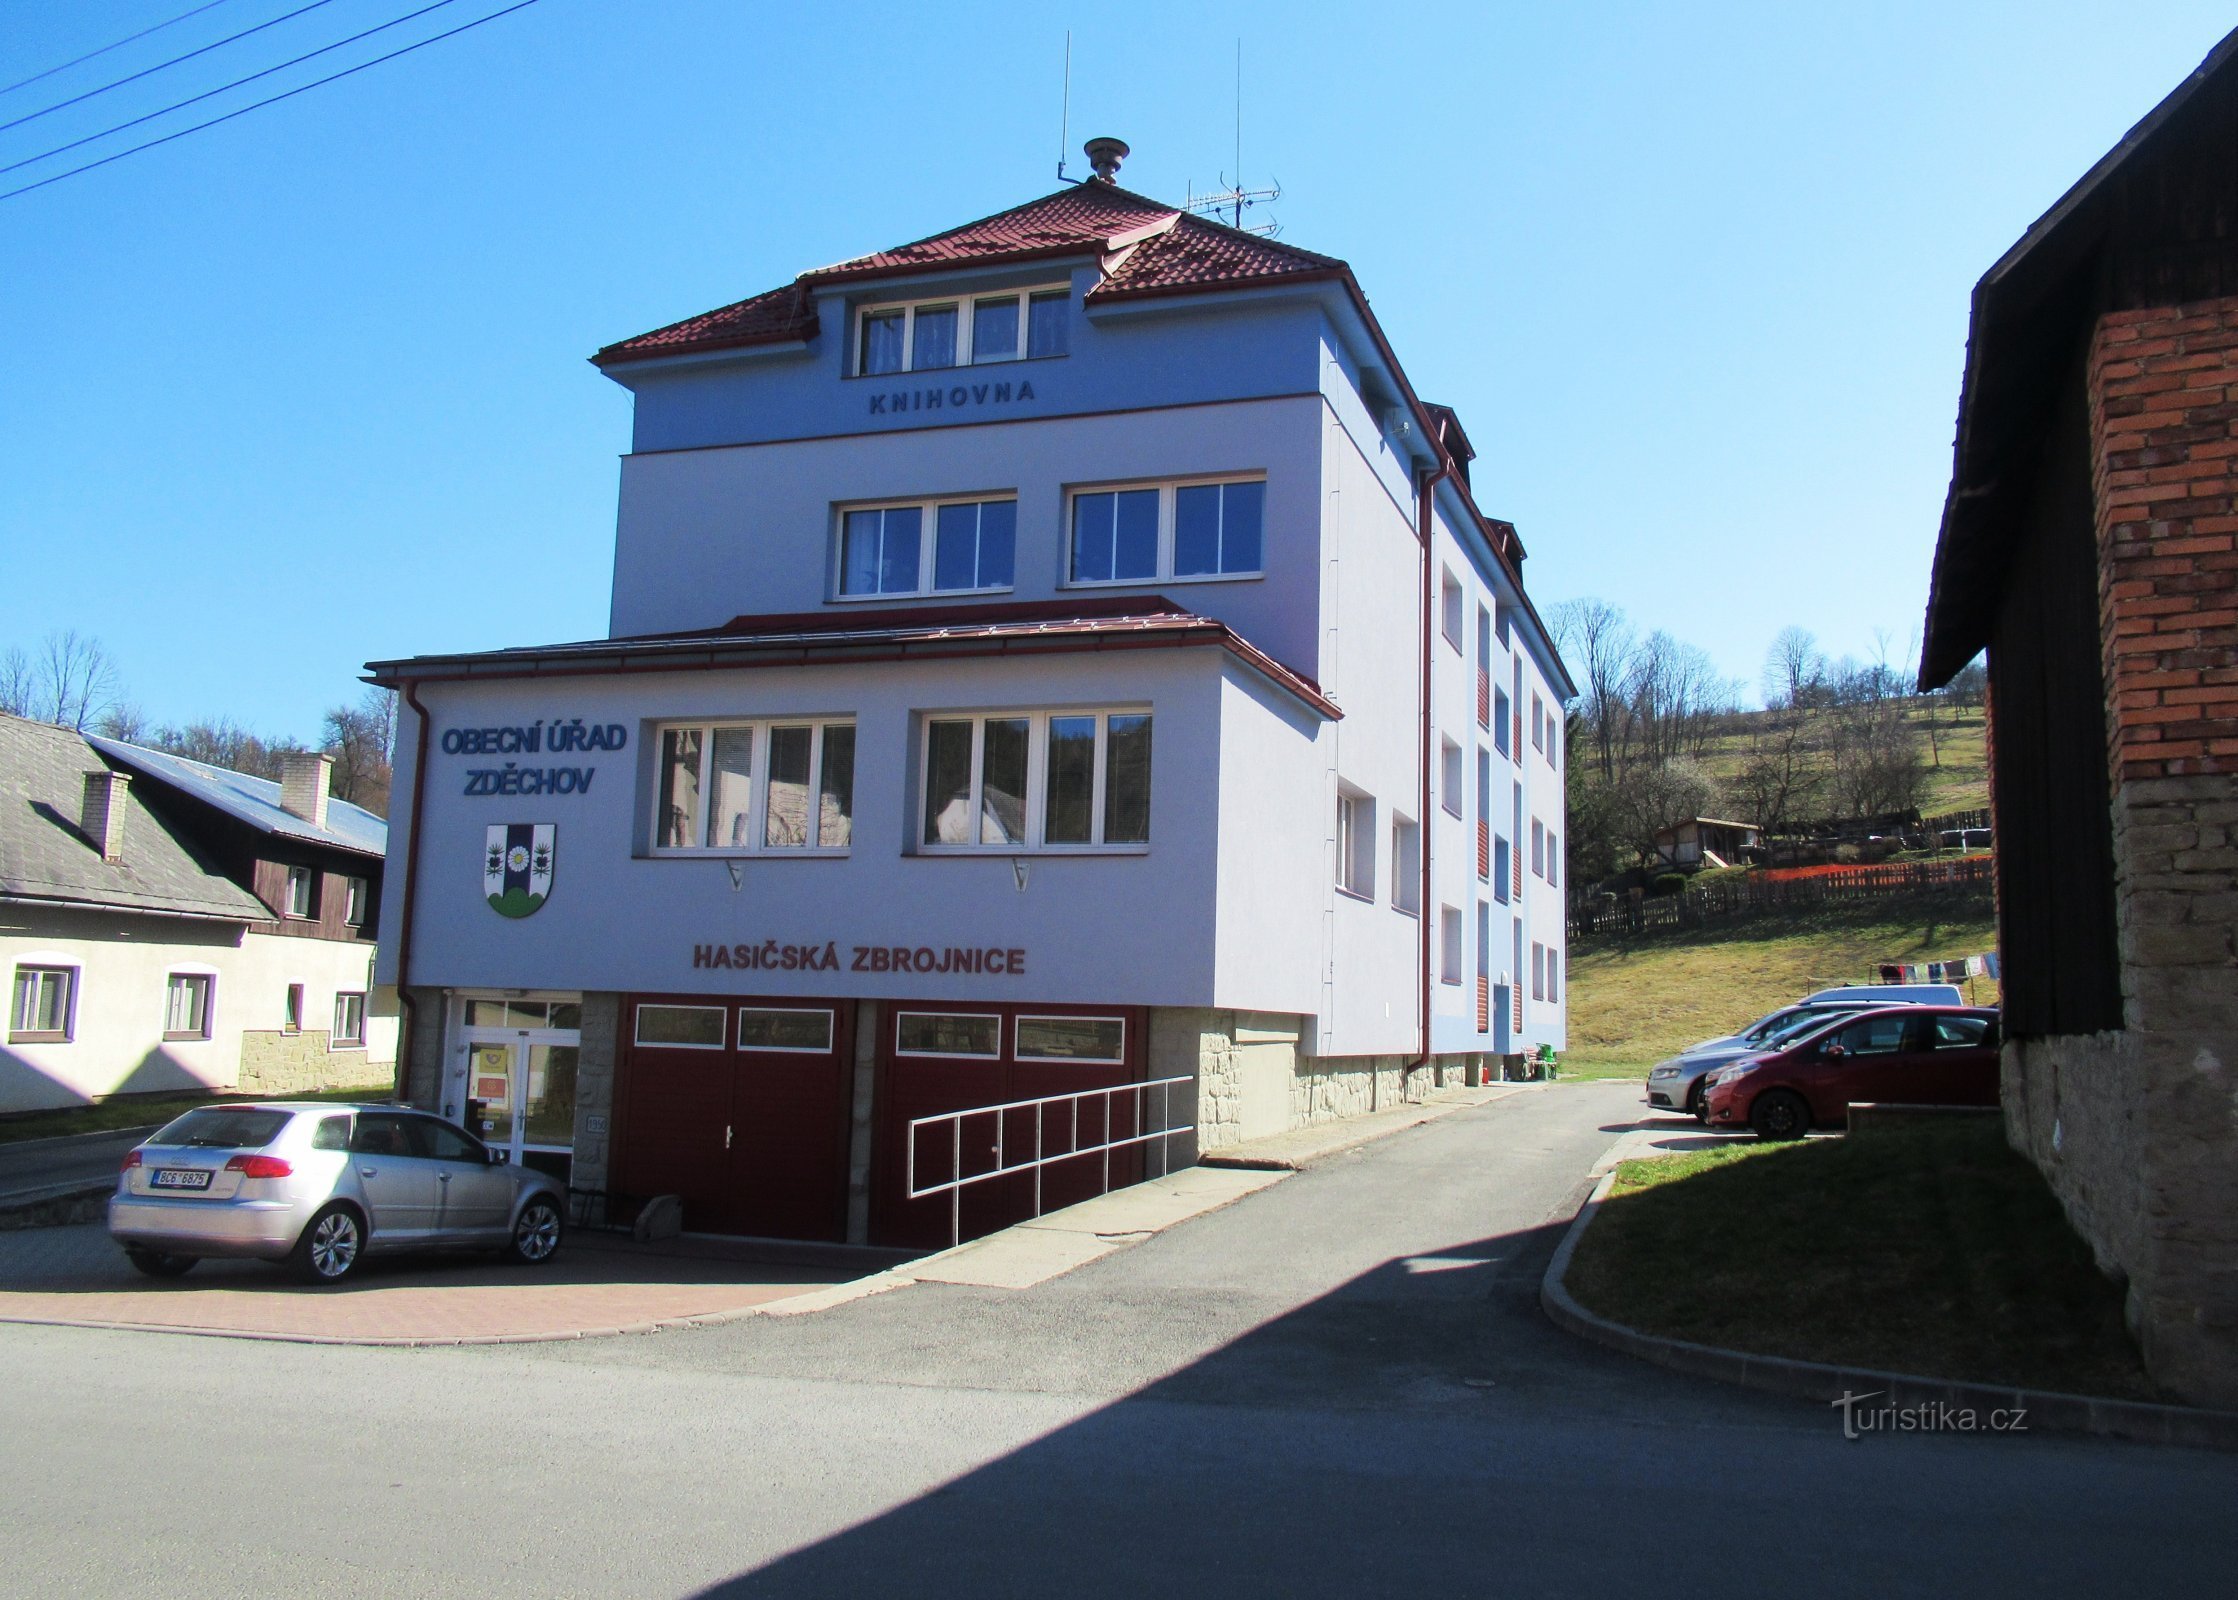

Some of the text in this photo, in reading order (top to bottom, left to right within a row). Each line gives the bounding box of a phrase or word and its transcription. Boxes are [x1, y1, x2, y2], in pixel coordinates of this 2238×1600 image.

[869, 380, 1035, 415] KNIHOVNA
[441, 718, 627, 755] OBECNÍ ÚŘAD
[464, 762, 595, 796] ZDĚCHOV
[693, 940, 1026, 975] HASIČSKÁ ZBROJNICE
[160, 1171, 205, 1185] 8C6 6875
